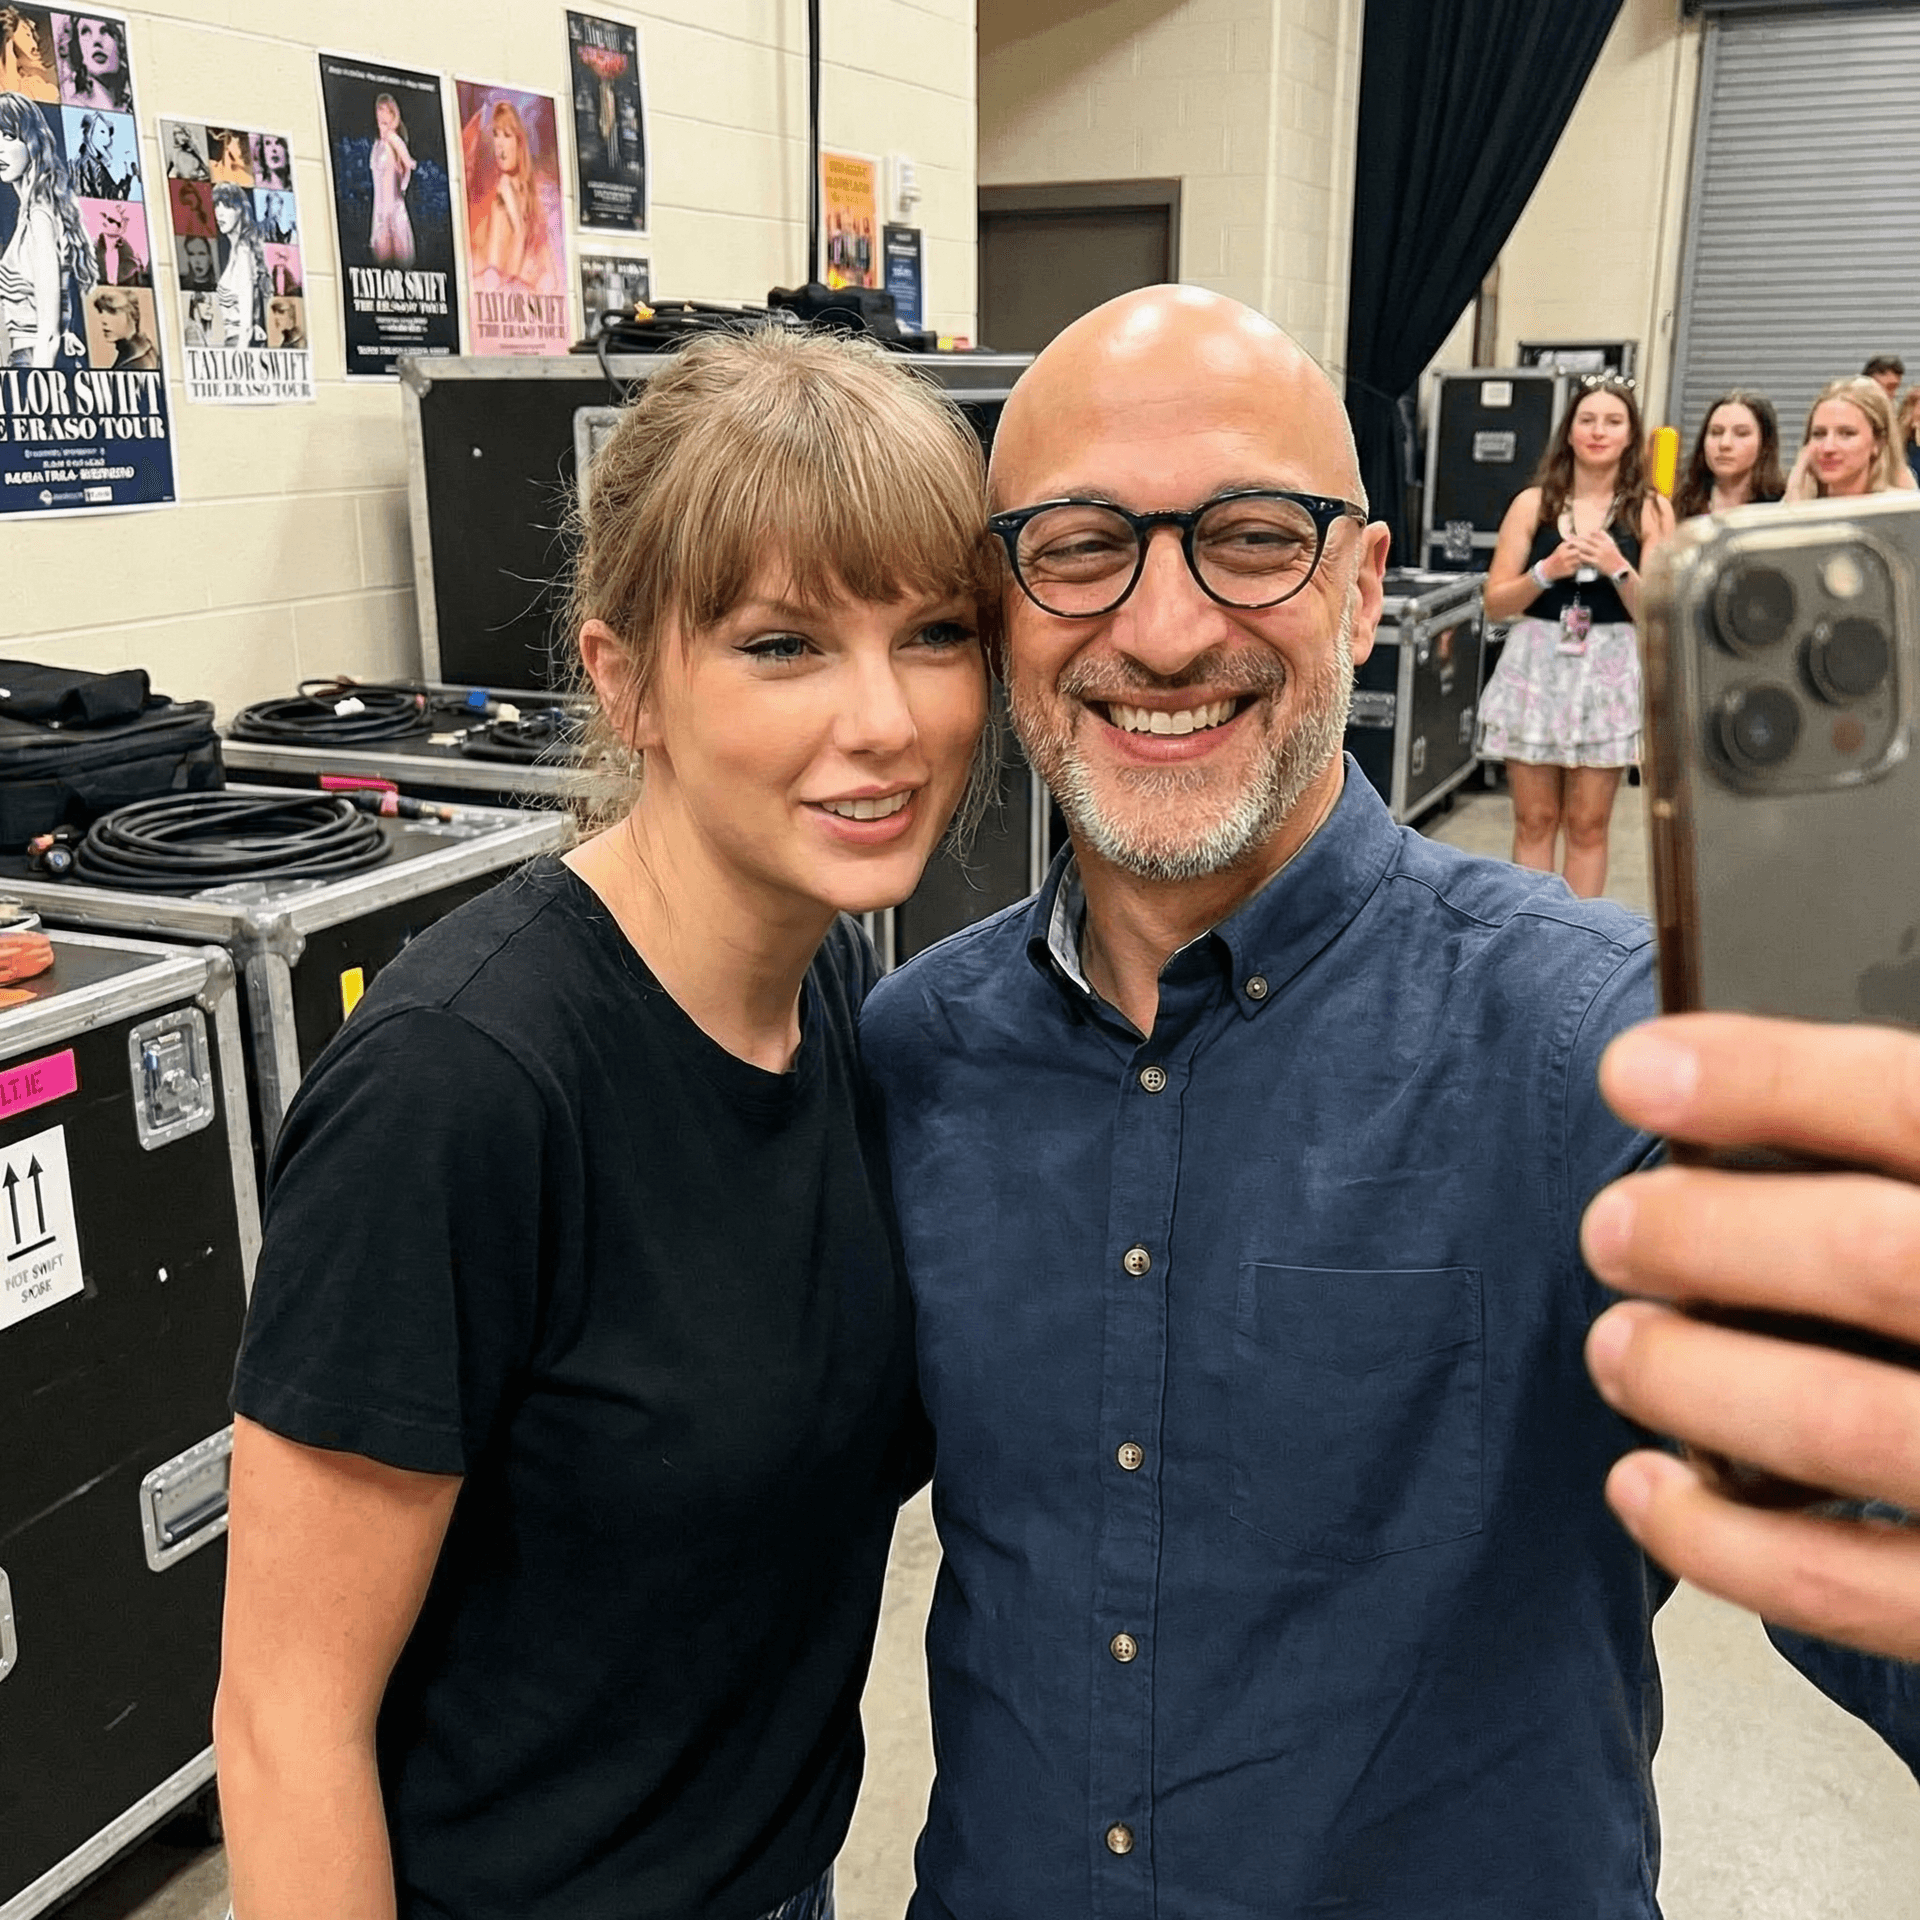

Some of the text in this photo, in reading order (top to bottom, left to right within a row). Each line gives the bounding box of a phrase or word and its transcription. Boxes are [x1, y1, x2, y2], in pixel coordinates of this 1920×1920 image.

[349, 266, 405, 300] TAYLOR
[188, 350, 308, 381] TAYLOR SWIFT
[74, 369, 161, 416] SWIFT
[12, 417, 98, 441] ERASO
[99, 416, 165, 440] TOUR
